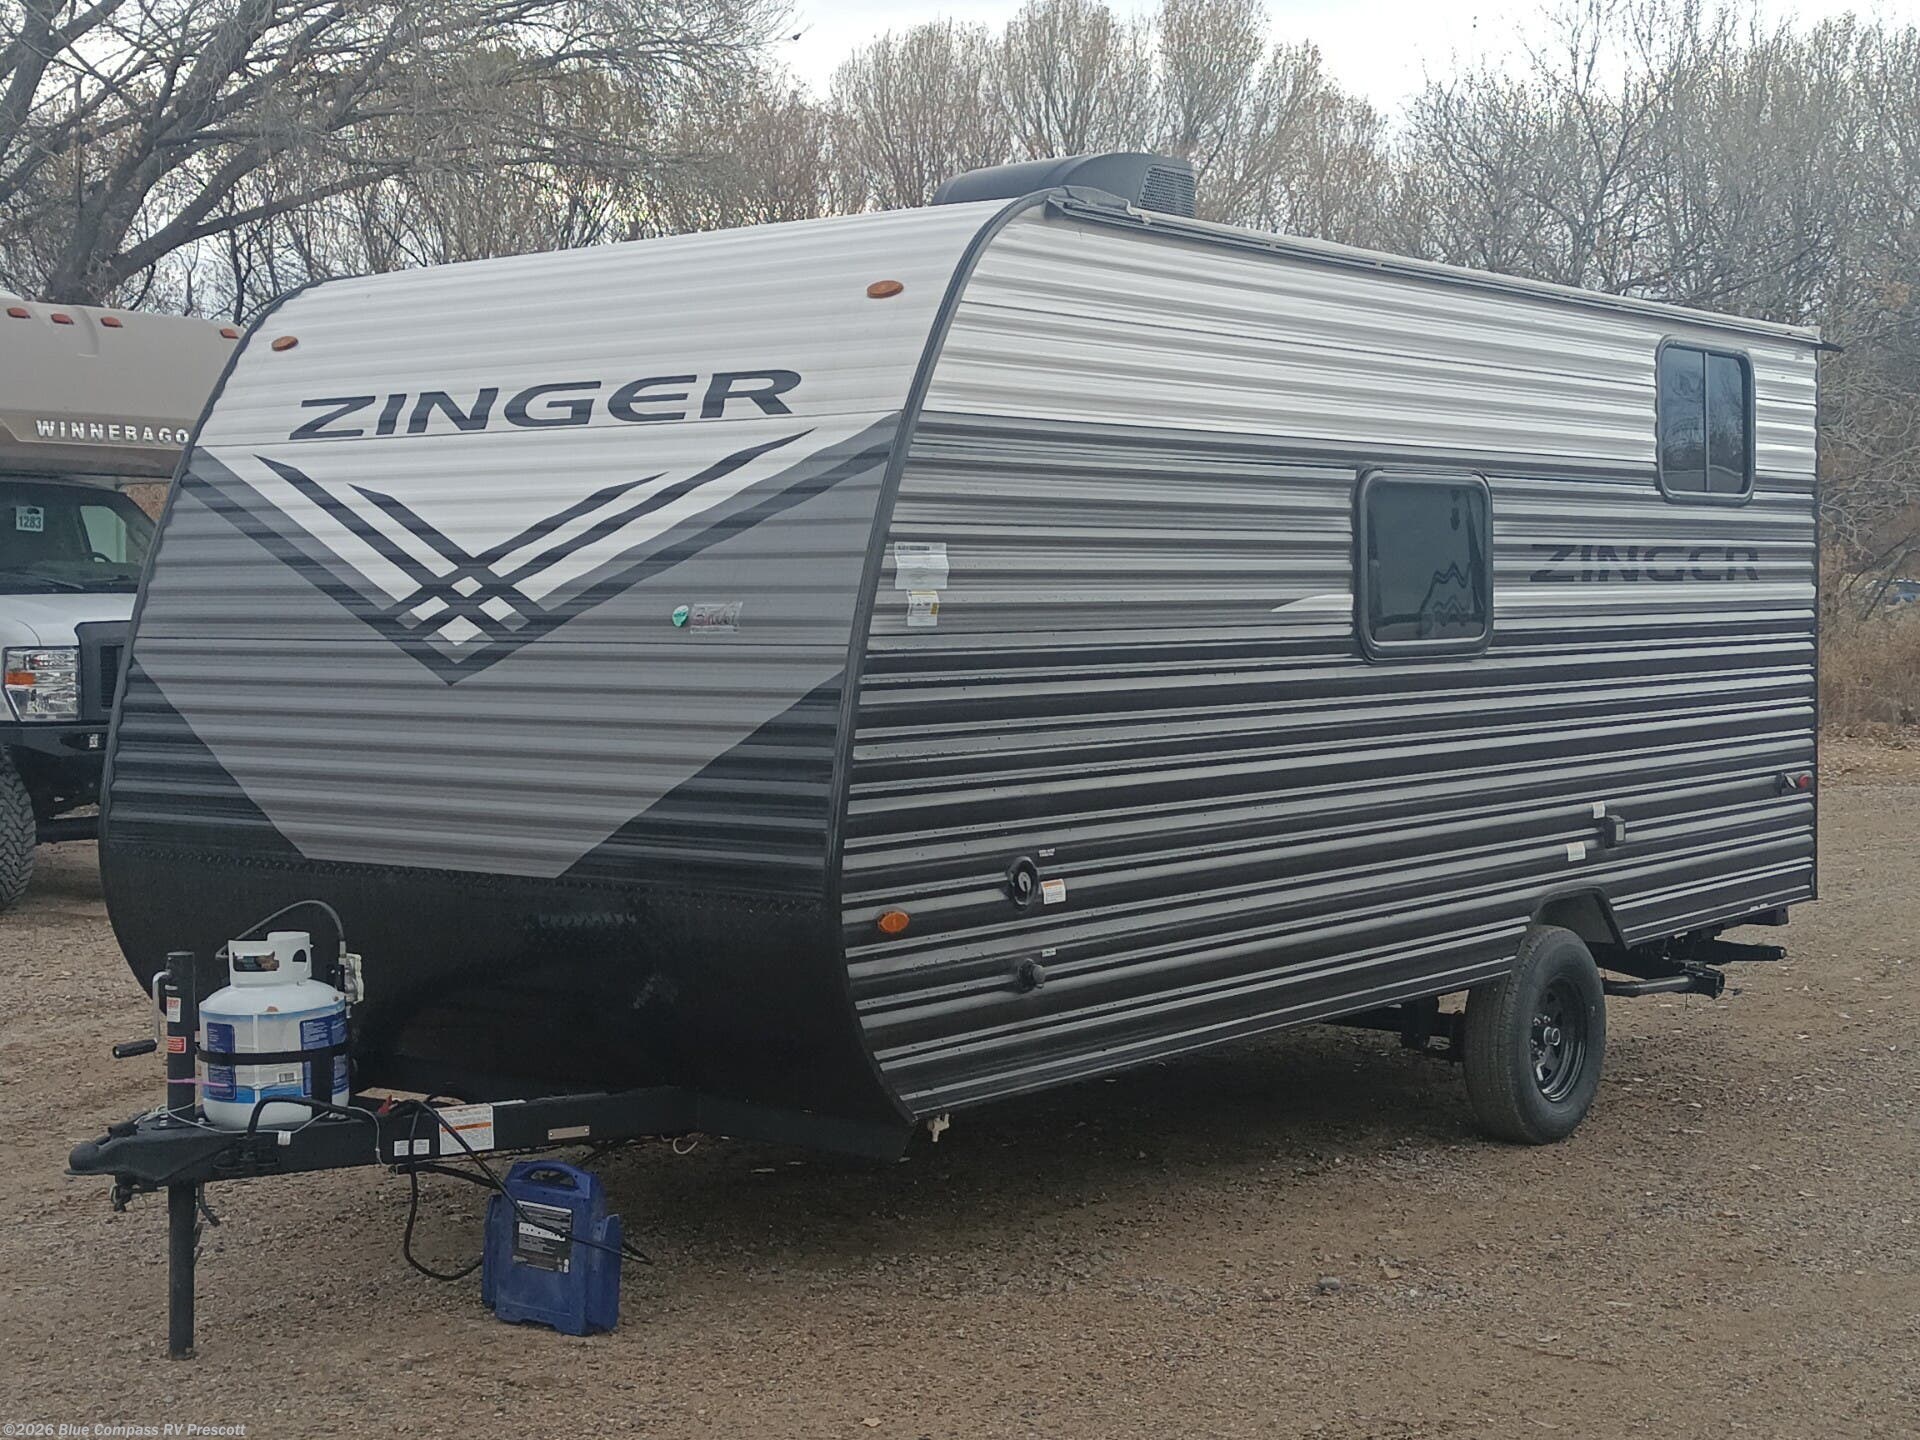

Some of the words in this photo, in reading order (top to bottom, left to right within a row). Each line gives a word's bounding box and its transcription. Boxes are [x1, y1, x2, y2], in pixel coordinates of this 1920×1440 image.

[288, 369, 802, 440] ZINGER
[35, 419, 190, 444] WINNEBAGO
[18, 515, 42, 529] 1283
[1529, 543, 1760, 582] ZINGER
